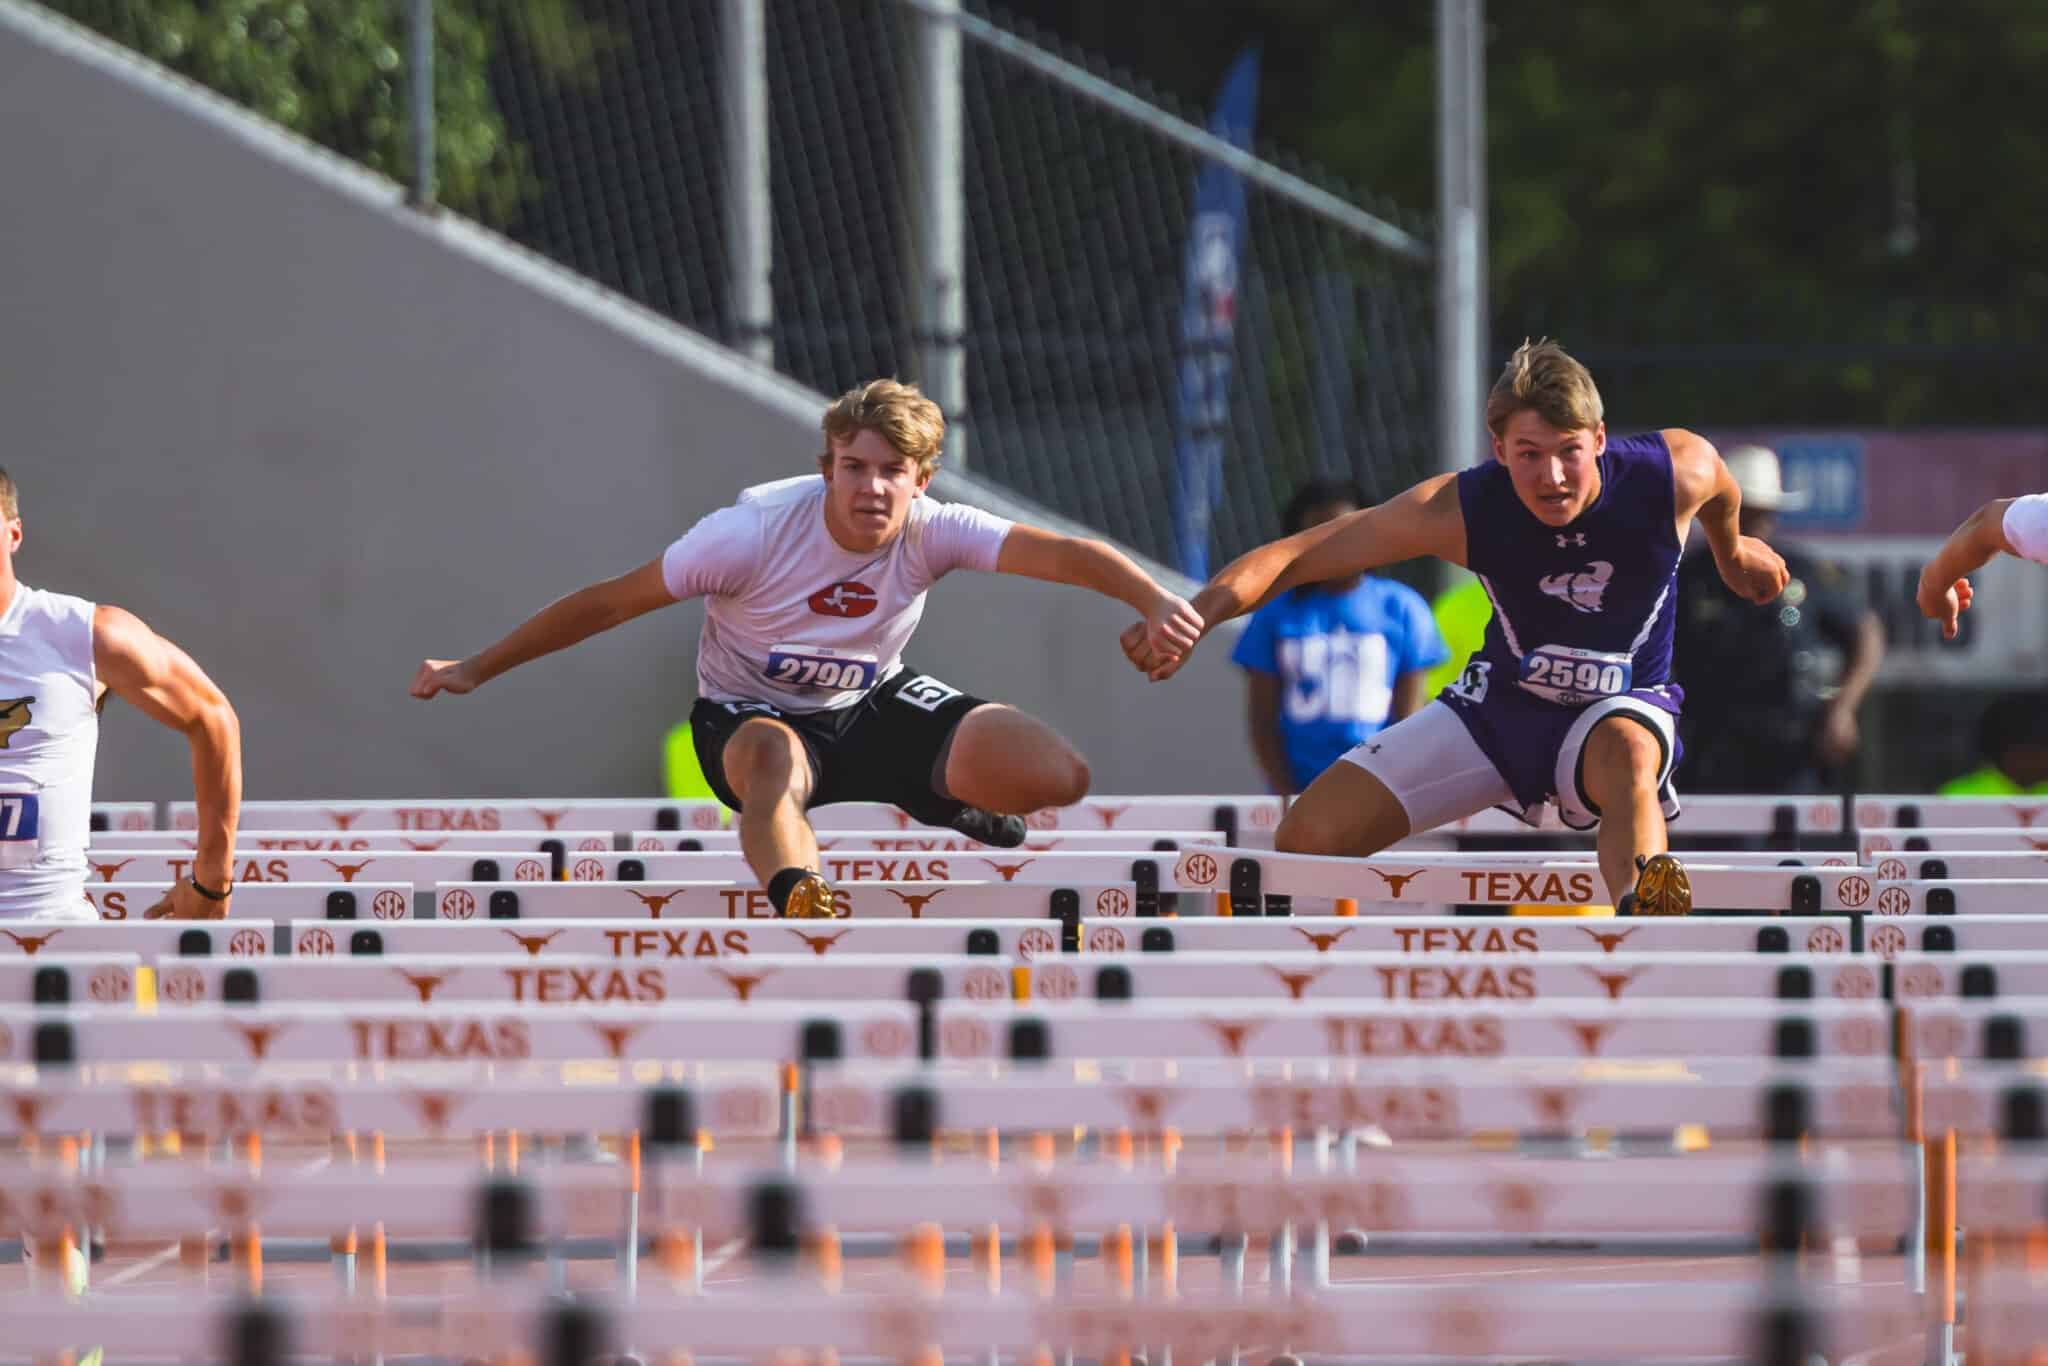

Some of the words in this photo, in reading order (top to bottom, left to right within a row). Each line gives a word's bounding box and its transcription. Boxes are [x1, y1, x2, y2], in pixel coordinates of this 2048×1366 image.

[773, 658, 865, 689] 2790
[1526, 655, 1624, 694] 2590
[901, 680, 949, 702] 5
[0, 798, 24, 836] 7
[395, 808, 501, 830] TEXAS
[167, 859, 289, 883] TAS
[827, 860, 950, 881] TEXAS
[1186, 854, 1217, 884] SEC
[1460, 871, 1594, 902] TEXAS
[1838, 875, 1870, 906] SEC
[1878, 887, 1910, 916] SEC
[373, 889, 405, 919] SEC
[443, 889, 475, 919] SEC
[719, 889, 853, 918] TES
[1096, 888, 1129, 917] SEC
[604, 929, 750, 957] TEXAS
[1393, 927, 1539, 952] TEXAS
[505, 968, 667, 1003] TEXAS
[1375, 965, 1538, 1000] TEXAS
[346, 1018, 533, 1060] TEXAS
[1321, 1016, 1505, 1056] TEXAS
